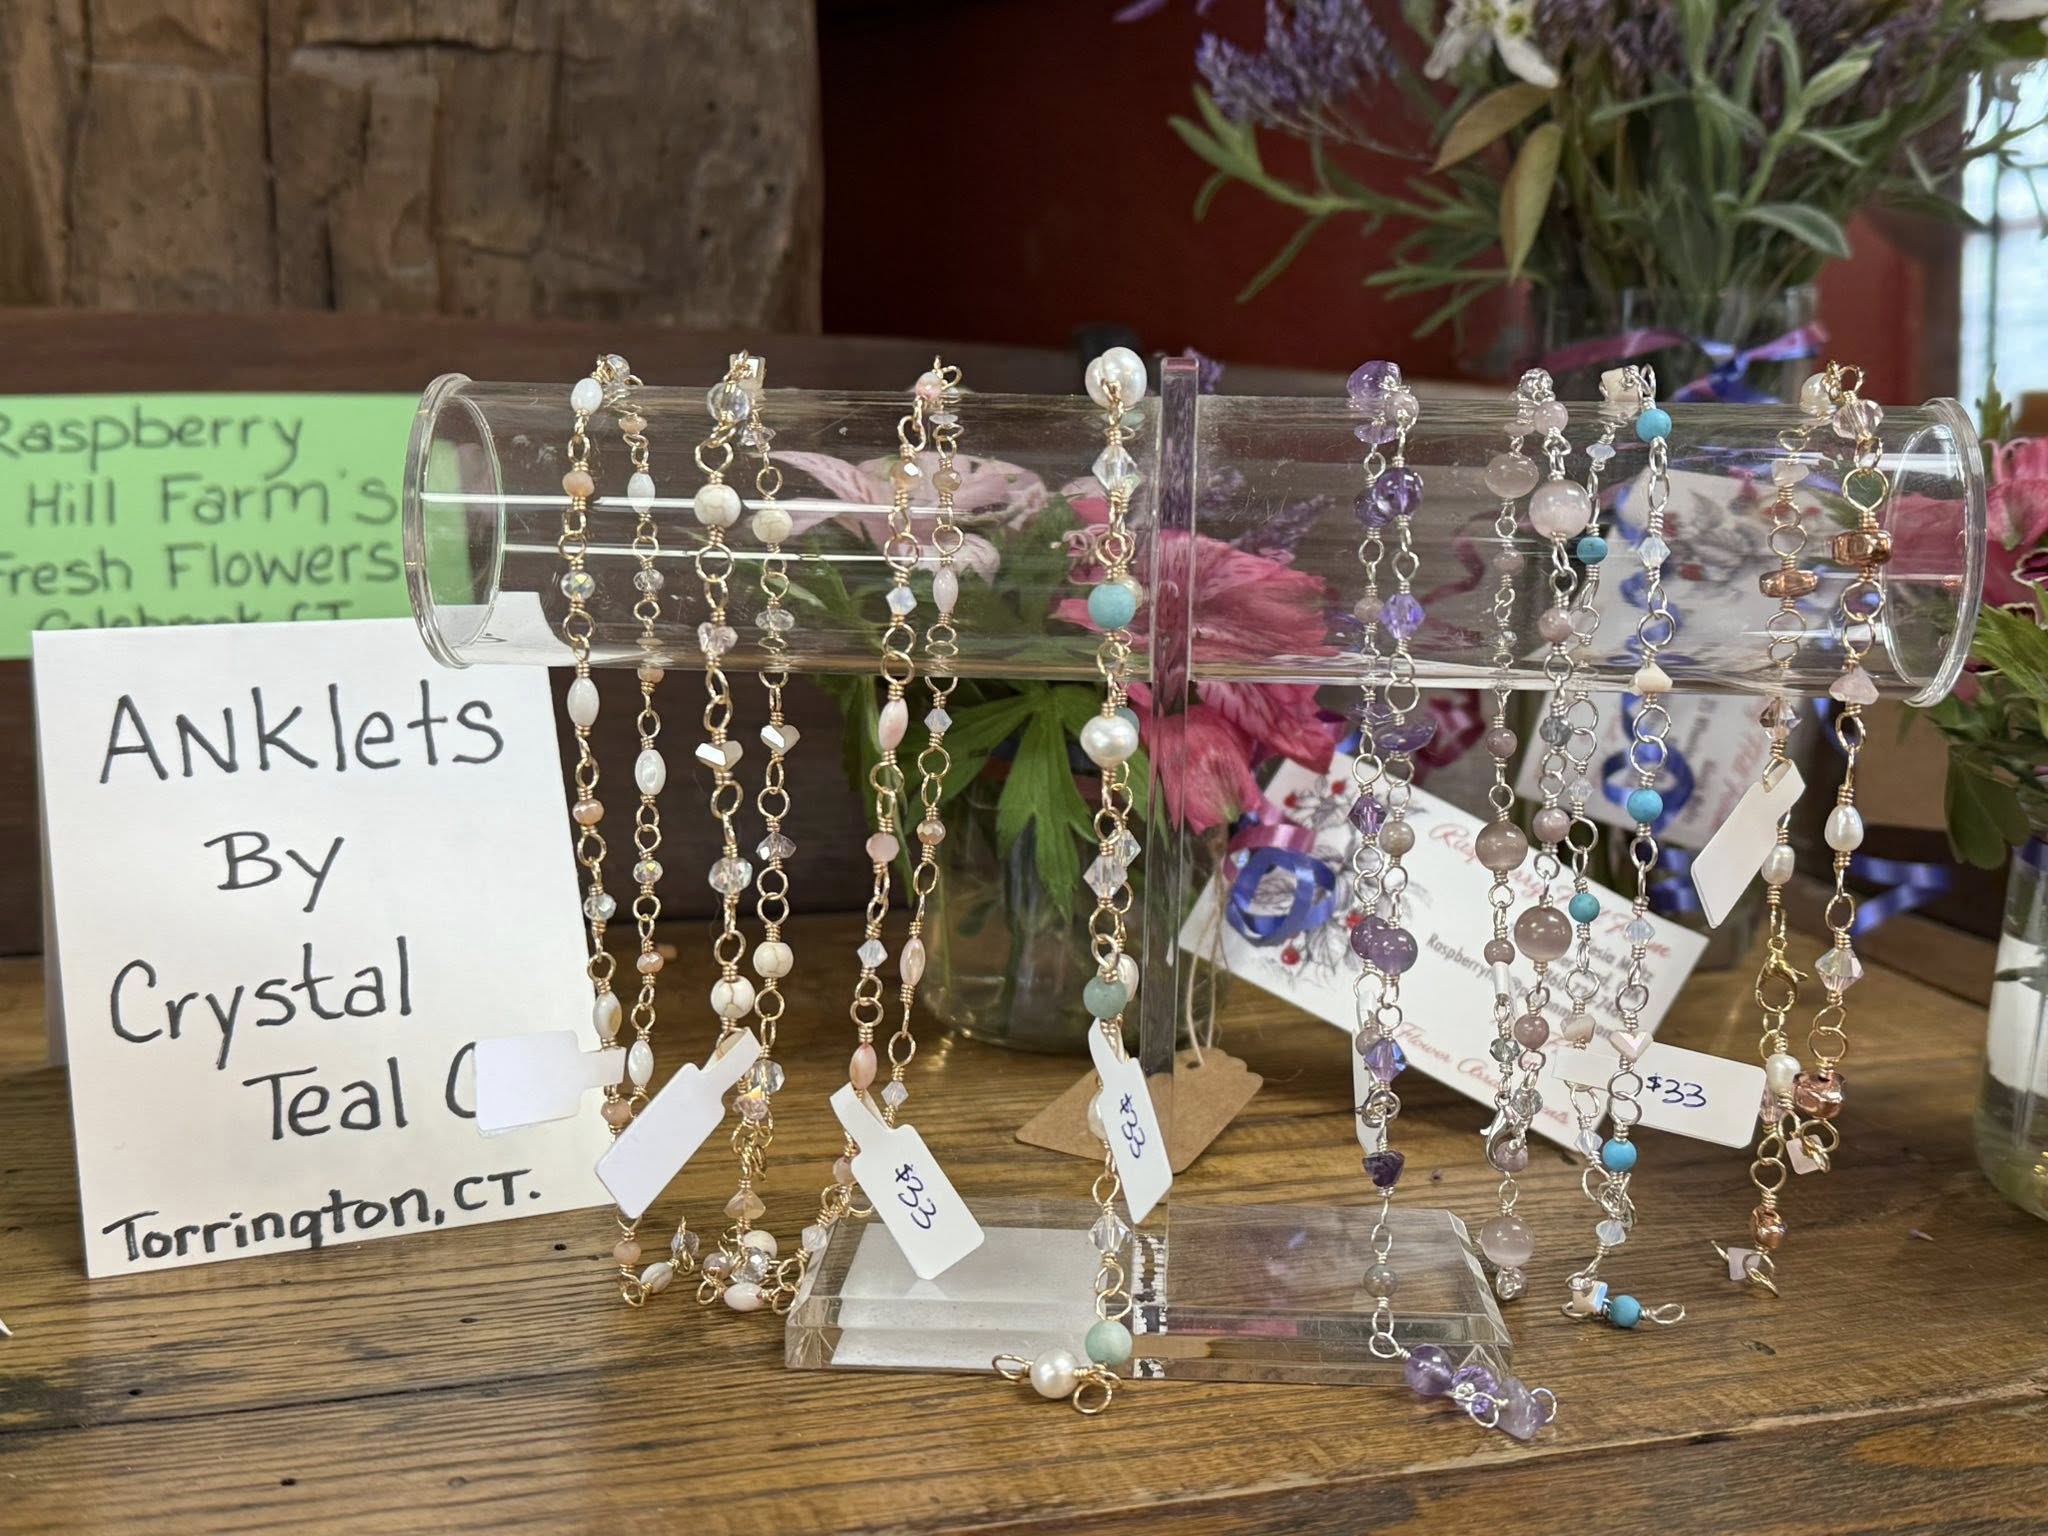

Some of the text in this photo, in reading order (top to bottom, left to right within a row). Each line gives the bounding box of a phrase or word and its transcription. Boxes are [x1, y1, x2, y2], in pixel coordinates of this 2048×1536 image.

[27, 470, 400, 526] Hill Farm's
[166, 541, 401, 590] Flowers
[204, 830, 344, 913] By
[110, 935, 413, 1070] Crystal
[242, 1056, 409, 1141] Teal
[1646, 1073, 1706, 1108] $33
[1120, 1092, 1147, 1159] $33
[895, 1163, 938, 1231] $33
